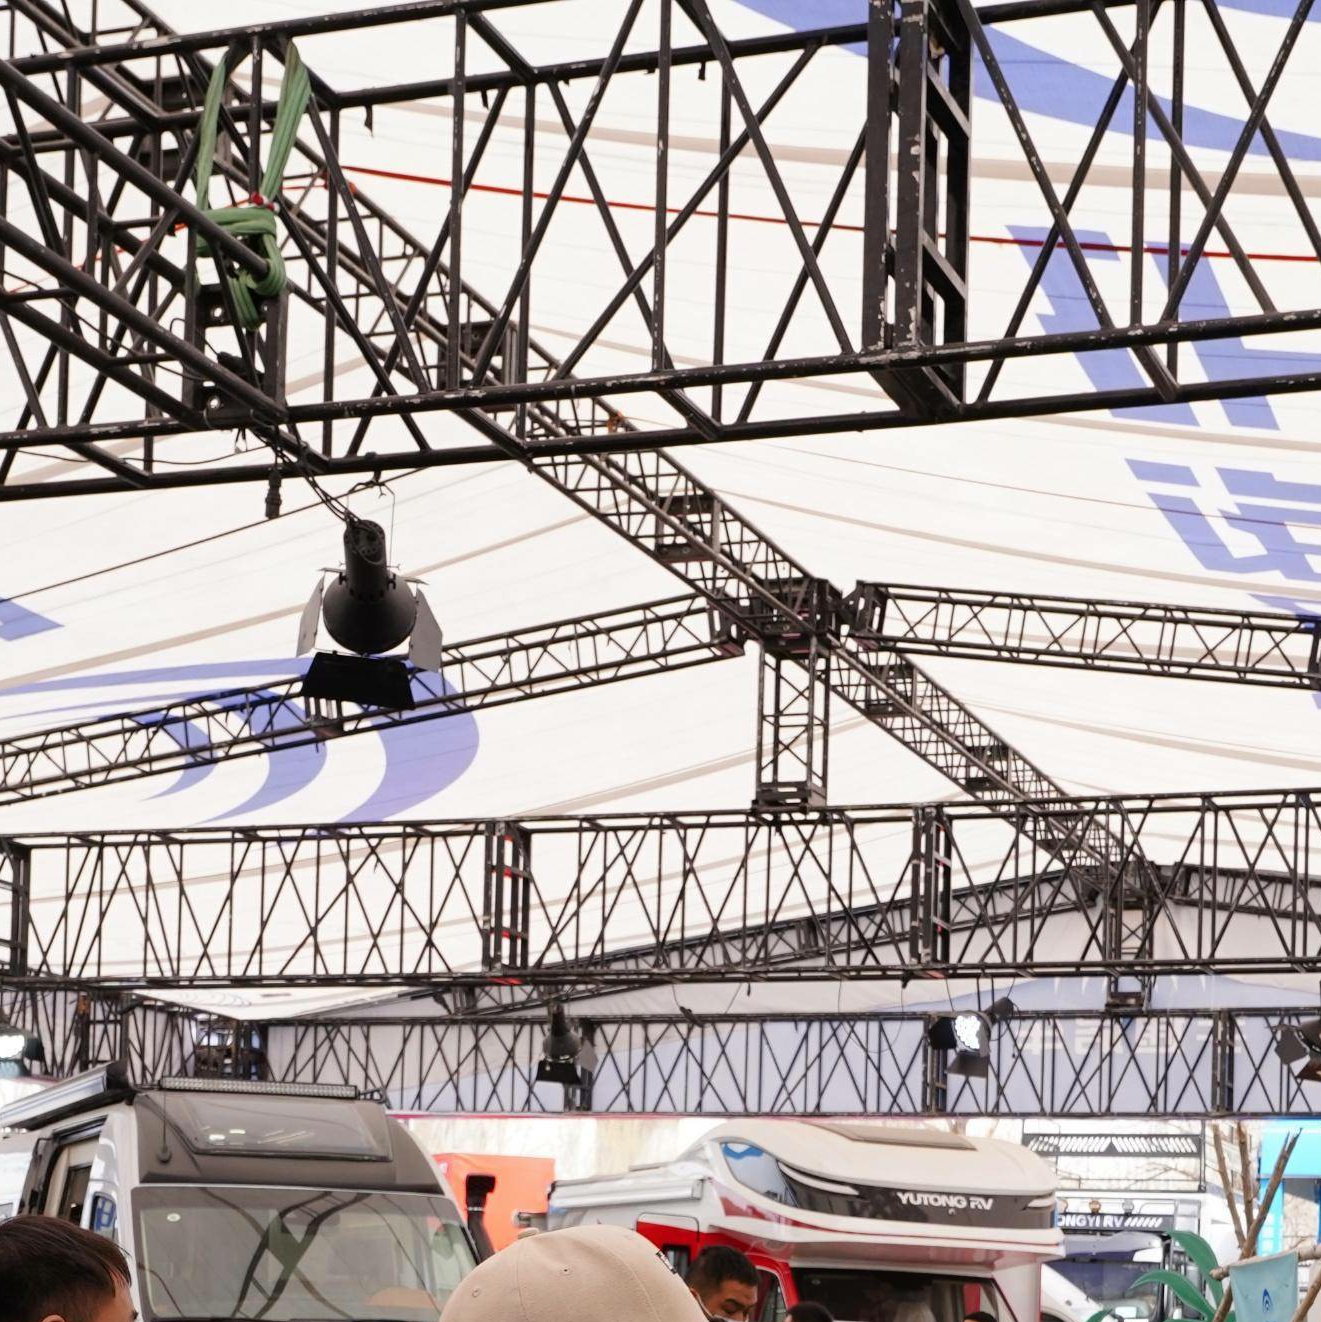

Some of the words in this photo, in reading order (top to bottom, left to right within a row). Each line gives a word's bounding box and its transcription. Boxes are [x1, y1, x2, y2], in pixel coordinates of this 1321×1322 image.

[897, 1191, 967, 1209] YUTONG
[969, 1196, 993, 1211] RV
[1103, 1216, 1124, 1228] RV
